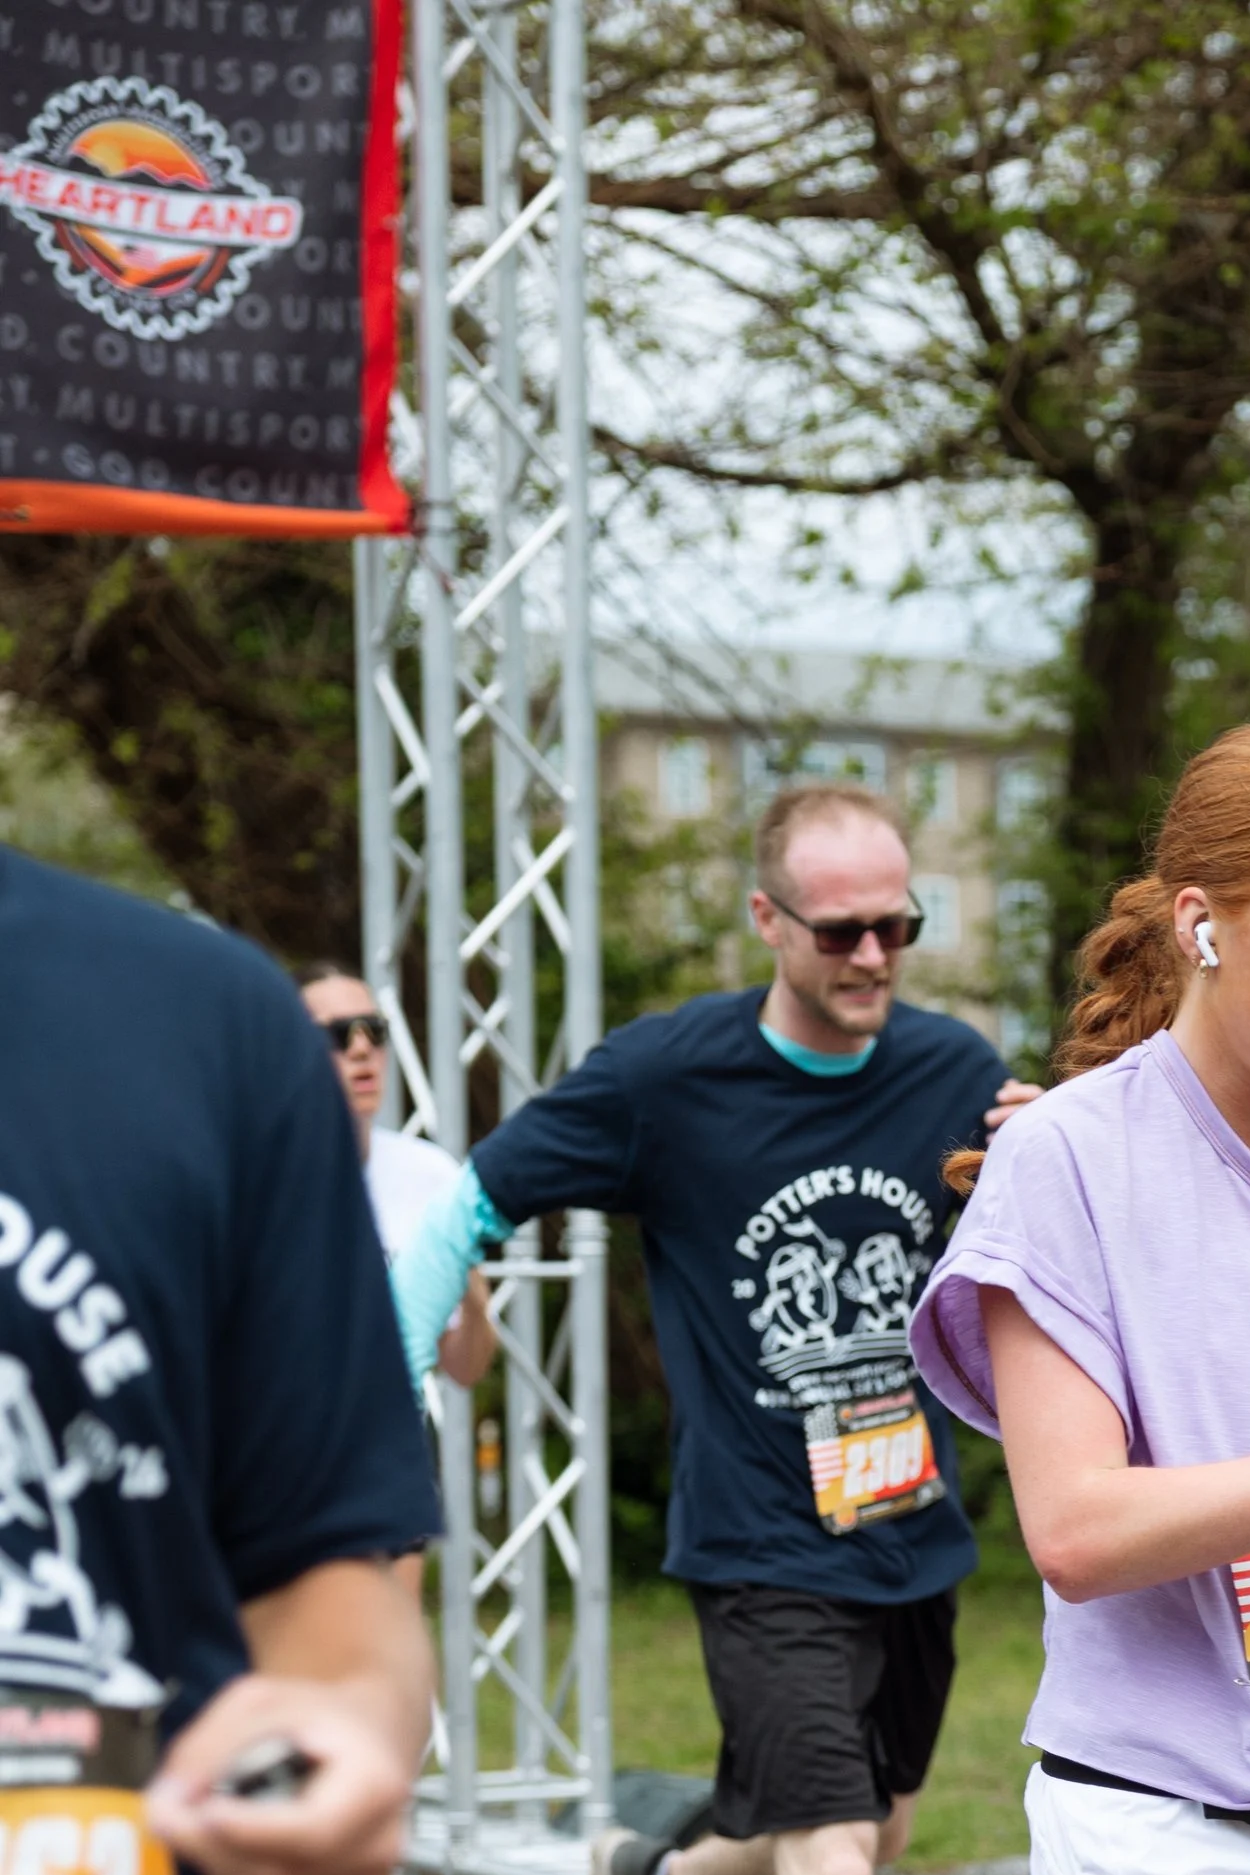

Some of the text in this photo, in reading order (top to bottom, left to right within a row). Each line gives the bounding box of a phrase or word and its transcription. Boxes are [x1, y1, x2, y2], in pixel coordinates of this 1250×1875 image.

[52, 0, 305, 40] UNTRY.
[0, 162, 293, 240] HEARTLAND
[56, 382, 366, 450] MULTISPOR
[735, 1165, 855, 1261] POTTER'S
